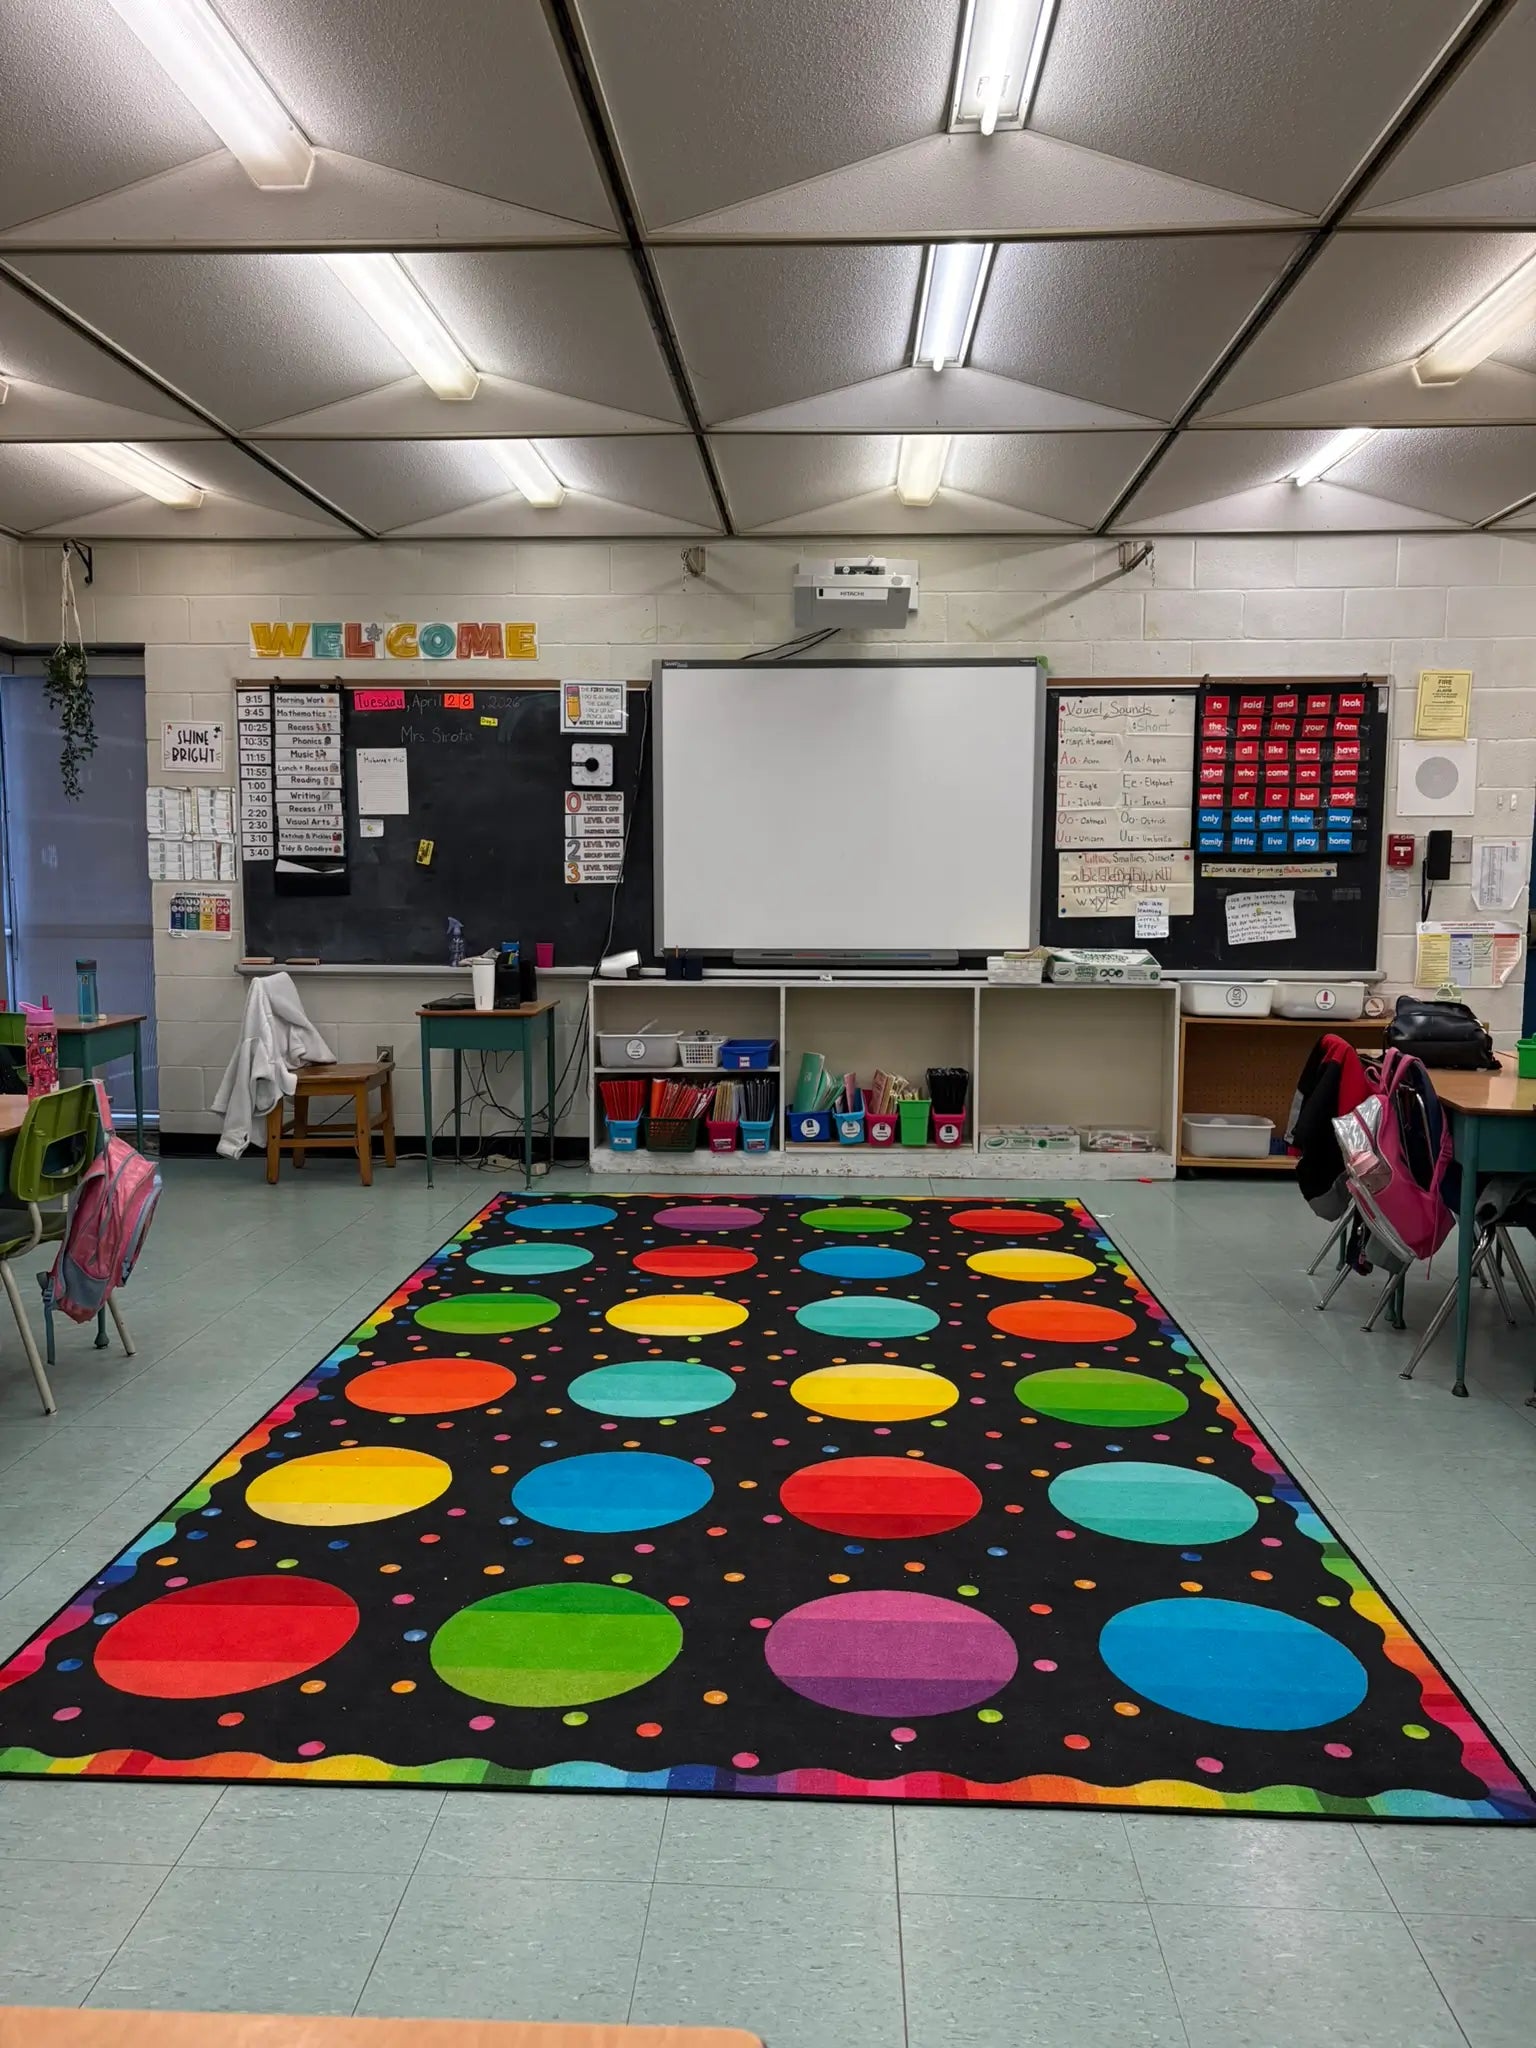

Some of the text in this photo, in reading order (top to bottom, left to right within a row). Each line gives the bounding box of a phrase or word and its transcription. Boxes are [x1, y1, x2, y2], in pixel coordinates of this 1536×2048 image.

[251, 622, 537, 659] WELCOME
[245, 695, 263, 703] 9:15
[276, 696, 325, 705] Morning Work
[1342, 698, 1361, 708] look
[1066, 701, 1152, 716] Vowel Sounds
[1213, 701, 1222, 710] to
[1242, 700, 1262, 710] said
[1277, 700, 1294, 708] and
[1312, 700, 1326, 708] see
[276, 710, 326, 718] Mathematics
[244, 724, 268, 732] 10:25
[288, 723, 314, 731] Recess
[1208, 722, 1222, 732] the
[1242, 723, 1257, 732] you
[1274, 722, 1290, 732] into
[1305, 724, 1325, 732] your
[1336, 722, 1358, 732] from
[177, 730, 209, 745] SHINE
[400, 726, 425, 743] Mrs
[244, 738, 269, 746] 10:35
[292, 737, 322, 745] Phonics
[290, 750, 314, 758] Music
[1205, 745, 1224, 754] they
[1242, 746, 1252, 754] all
[1268, 745, 1284, 754] like
[1299, 746, 1316, 754] was
[1337, 745, 1358, 754] have
[172, 747, 215, 763] BRIGHT
[246, 754, 266, 762] 11:15
[246, 768, 267, 776] 11:55
[278, 764, 298, 772] Lunch
[1203, 768, 1223, 777] what
[1238, 768, 1255, 776] who
[1334, 768, 1356, 776] some
[1267, 769, 1288, 777] come
[1300, 770, 1316, 778] are
[290, 776, 320, 785] Reading
[1144, 778, 1175, 788] Elephant
[248, 782, 266, 790] 1:00
[248, 795, 267, 803] 1:40
[290, 792, 320, 802] Writing
[604, 794, 622, 802] ZERO
[1238, 792, 1250, 800] of
[1272, 792, 1282, 800] or
[1300, 792, 1314, 801] but
[248, 810, 268, 818] 2:20
[1234, 814, 1254, 823] does
[1260, 814, 1282, 823] after
[1292, 814, 1310, 823] their
[286, 818, 330, 826] Visual Arts
[584, 816, 620, 824] LEVEL ONE
[1202, 814, 1220, 824] only
[1328, 814, 1351, 824] away
[248, 822, 268, 830] 2:30
[250, 835, 268, 843] 3:10
[1200, 838, 1223, 847] family
[1234, 837, 1254, 846] little
[1267, 837, 1282, 846] live
[1296, 837, 1316, 847] play
[1328, 836, 1351, 845] home
[250, 849, 270, 857] 3:40
[566, 840, 581, 860] 2
[566, 862, 581, 883] 3
[583, 864, 602, 872] LEVEL
[1203, 864, 1210, 873] I
